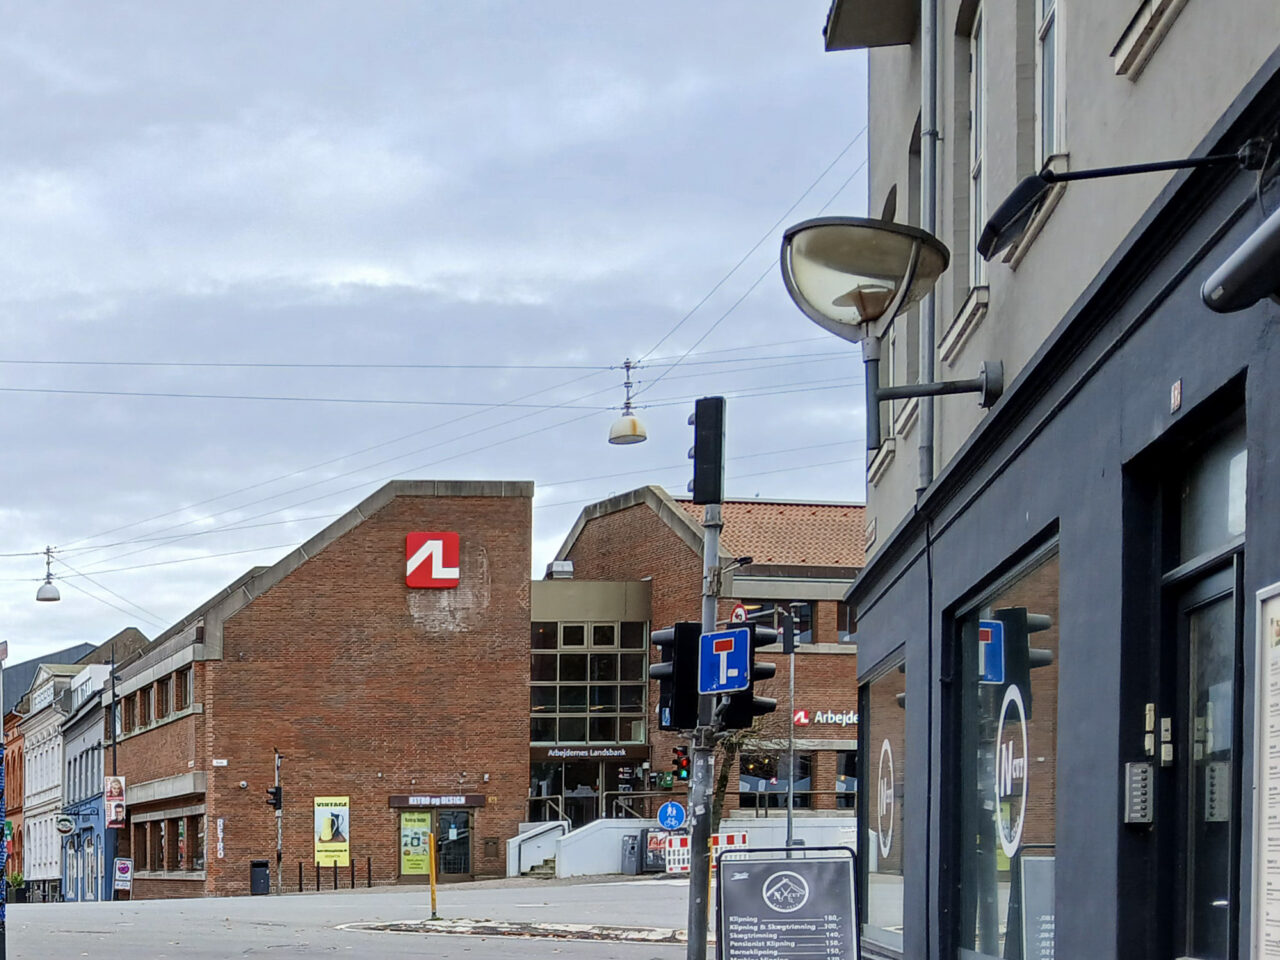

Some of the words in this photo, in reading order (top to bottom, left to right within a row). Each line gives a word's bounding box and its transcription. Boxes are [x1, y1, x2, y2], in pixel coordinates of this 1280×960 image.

[548, 748, 588, 758] Arbejdernes
[589, 748, 626, 757] Landsbank
[729, 915, 758, 924] Klipning
[729, 924, 758, 932] Klipning
[729, 940, 765, 948] Pensionist
[766, 940, 796, 949] Klipning
